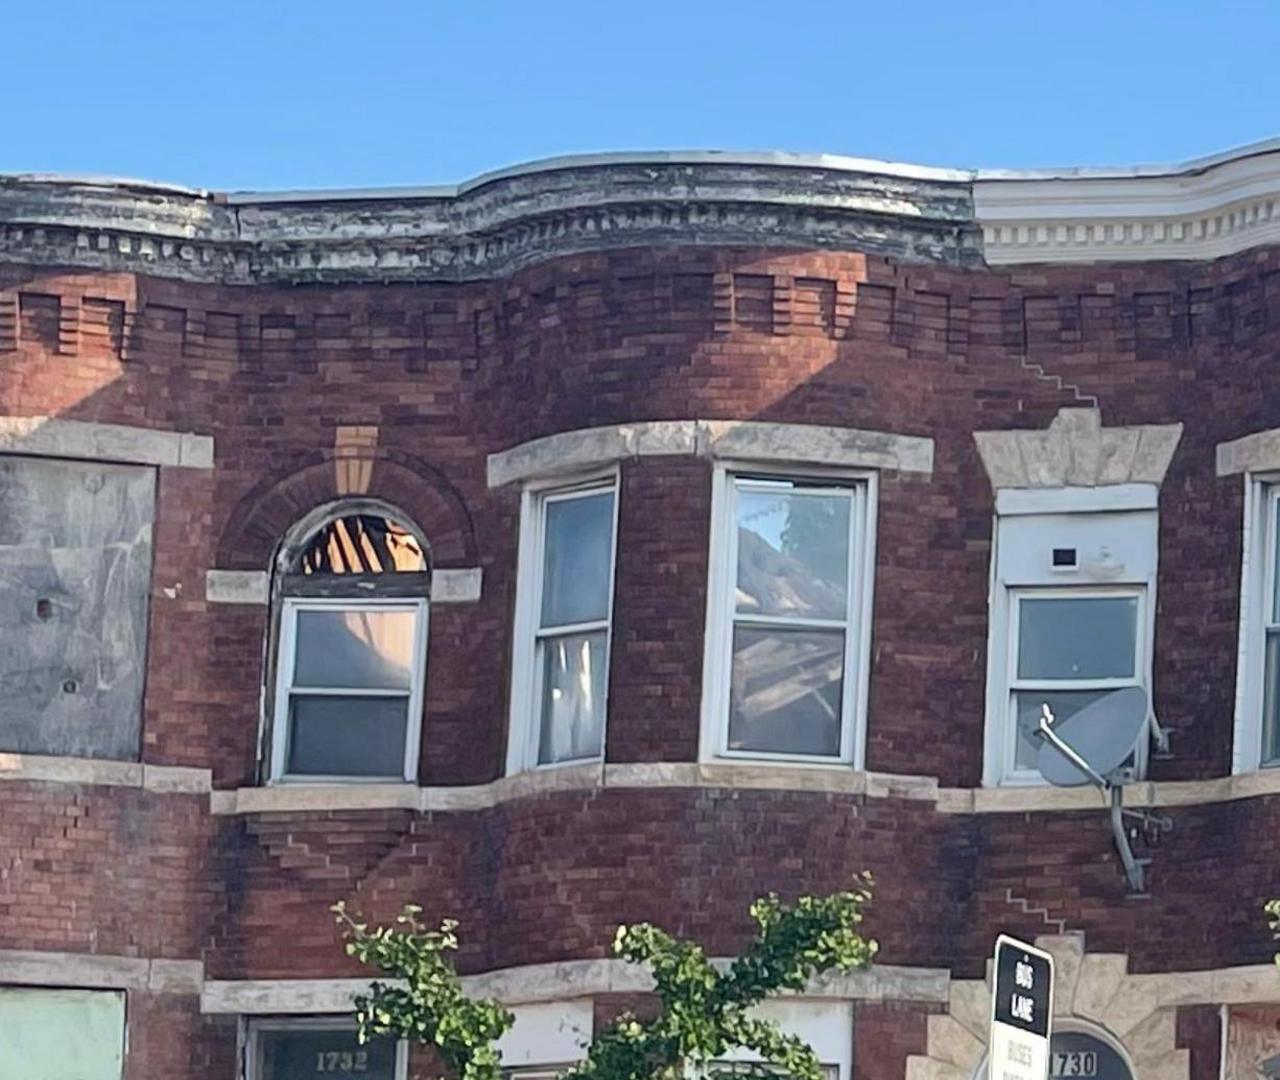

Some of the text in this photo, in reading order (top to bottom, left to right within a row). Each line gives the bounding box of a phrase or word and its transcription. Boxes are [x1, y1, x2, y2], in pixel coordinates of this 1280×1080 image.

[1015, 961, 1034, 989] BUS
[1011, 993, 1034, 1022] LANE
[316, 1051, 368, 1072] 1732
